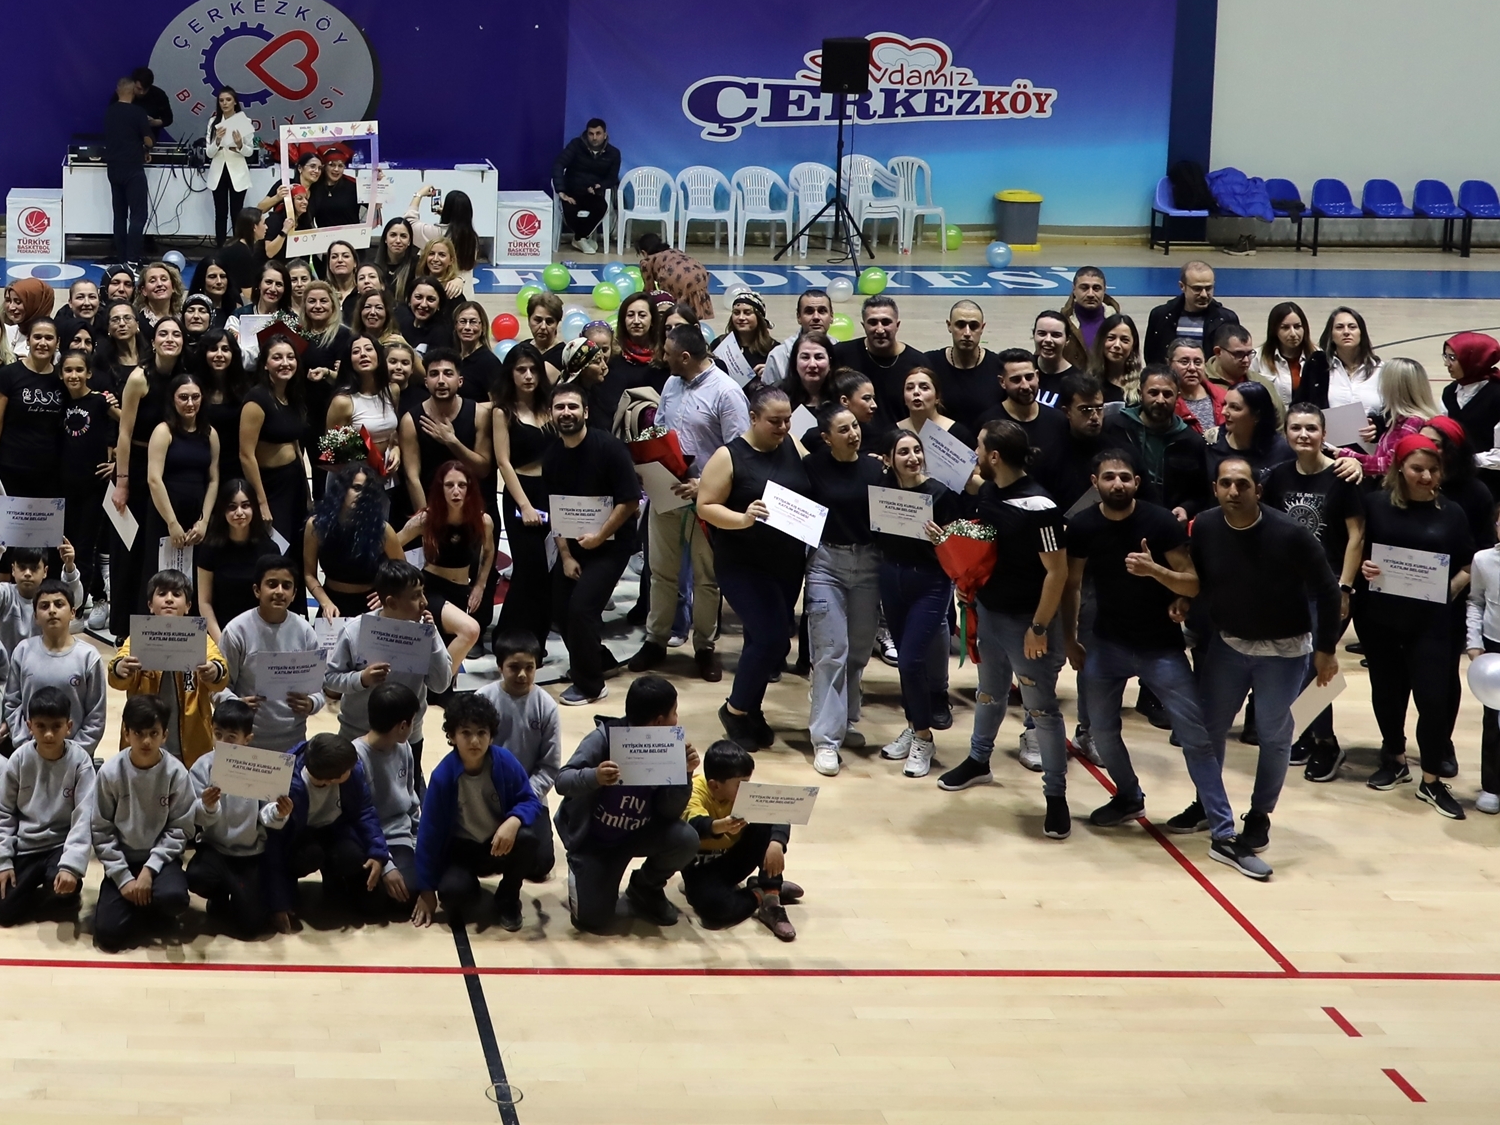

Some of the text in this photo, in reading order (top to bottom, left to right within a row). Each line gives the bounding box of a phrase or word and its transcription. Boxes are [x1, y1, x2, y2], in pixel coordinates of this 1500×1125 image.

[175, 86, 344, 132] BEDİYESİ
[688, 80, 1053, 137] ÇERKEZKÖY
[17, 237, 50, 245] TÜRKİYE
[508, 240, 540, 248] TÜRKİYE
[620, 795, 646, 814] Fly
